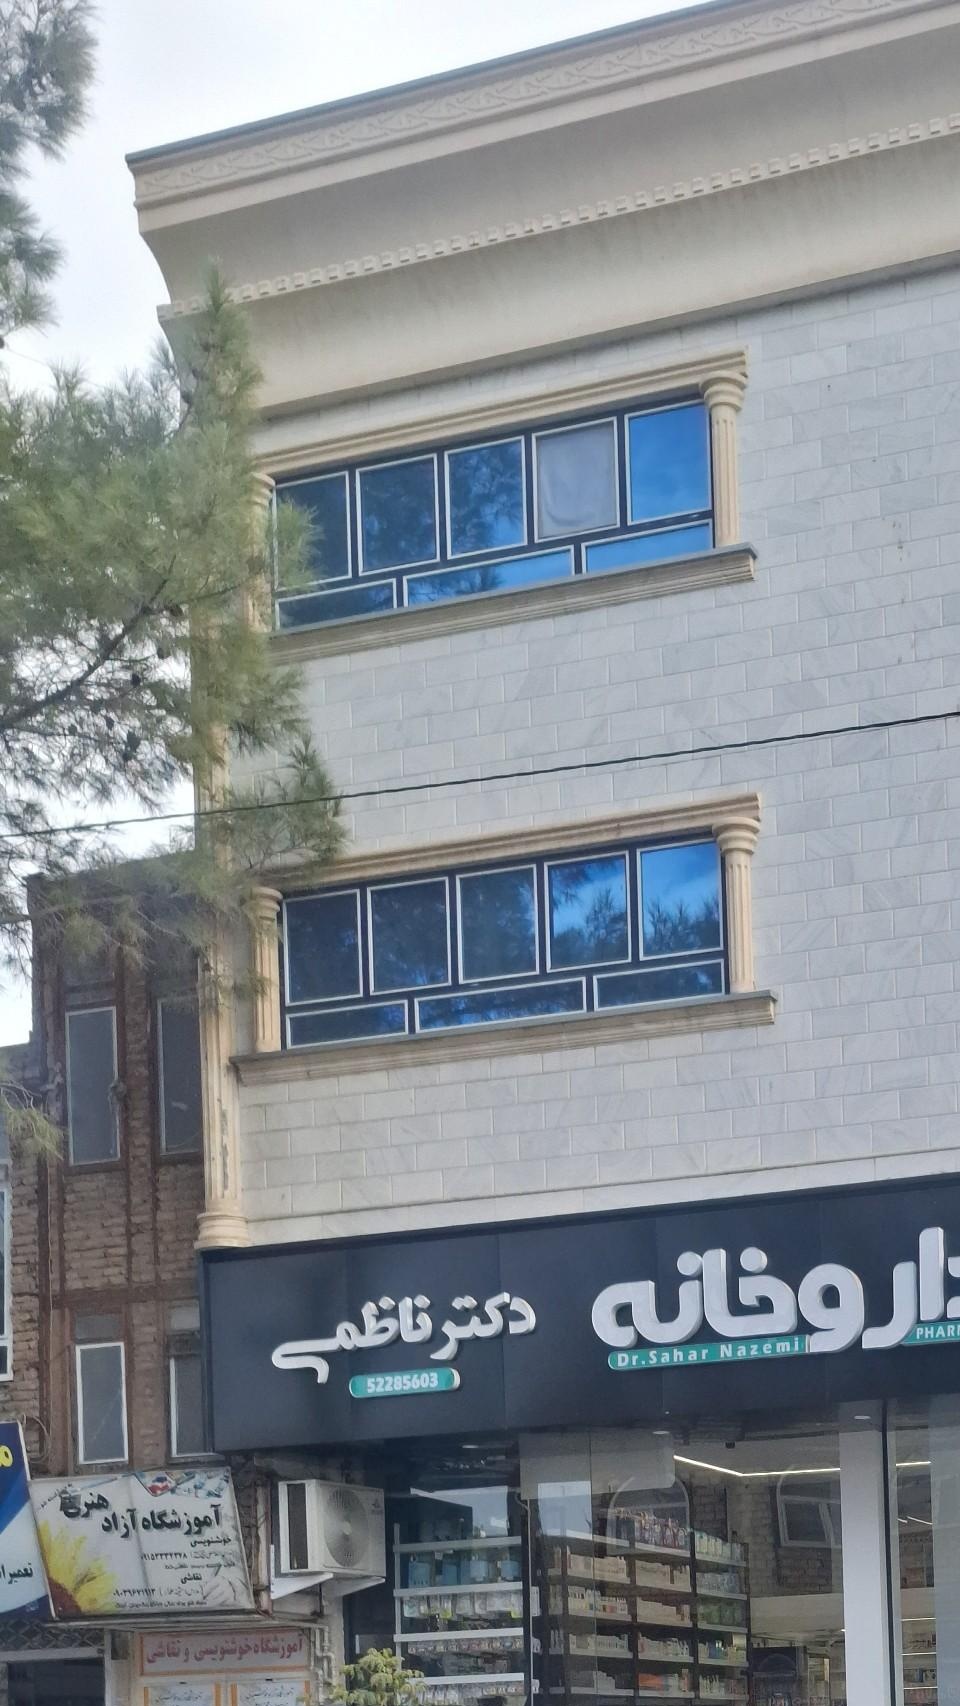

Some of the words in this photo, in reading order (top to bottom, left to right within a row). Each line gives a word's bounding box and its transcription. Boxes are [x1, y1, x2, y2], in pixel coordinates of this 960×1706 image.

[271, 1295, 432, 1384] ناظمی
[430, 1292, 536, 1360] دکتر
[720, 1337, 800, 1359] Nazemi
[367, 1372, 438, 1393] 52285603
[101, 1508, 137, 1538] آزاد
[142, 1503, 221, 1535] آموزشگاه
[180, 1573, 203, 1585] نقاشی
